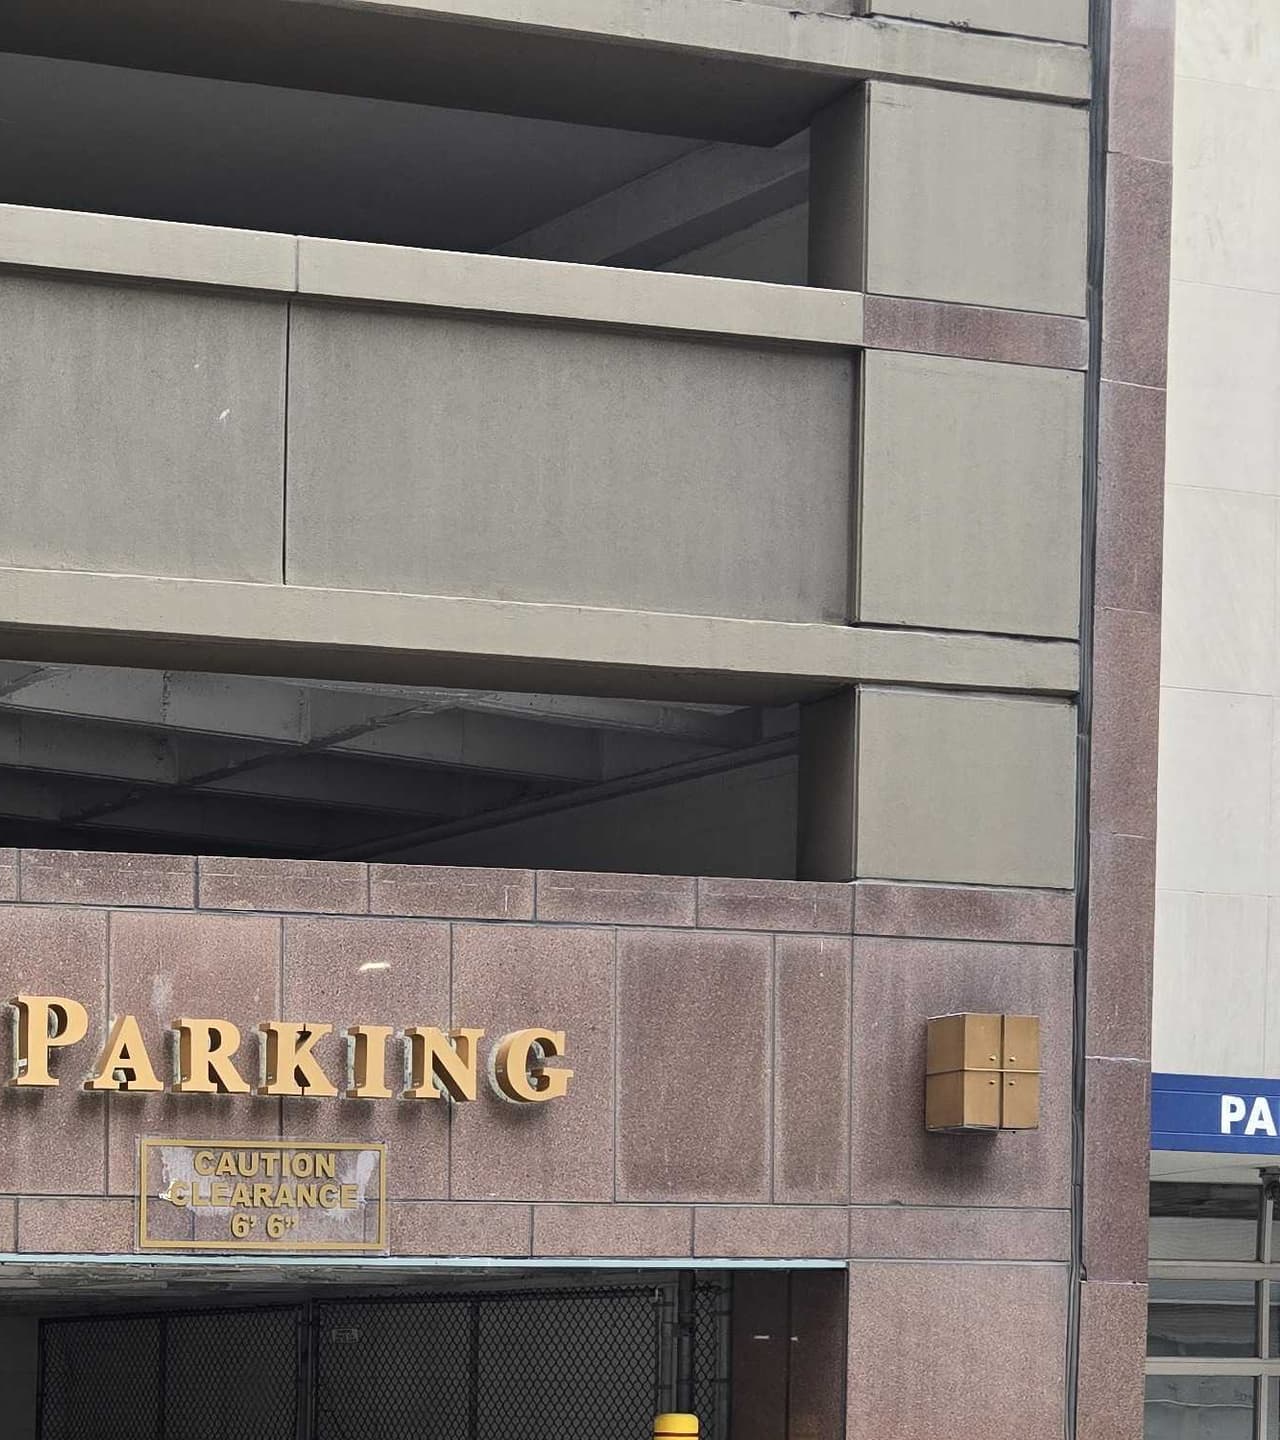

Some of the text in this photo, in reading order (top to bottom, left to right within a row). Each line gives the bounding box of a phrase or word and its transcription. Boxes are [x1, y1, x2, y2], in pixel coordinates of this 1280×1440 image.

[8, 994, 575, 1102] PARKING
[1221, 1095, 1278, 1136] PA
[193, 1150, 337, 1178] CAUTION
[169, 1181, 359, 1209] CLEARANCE
